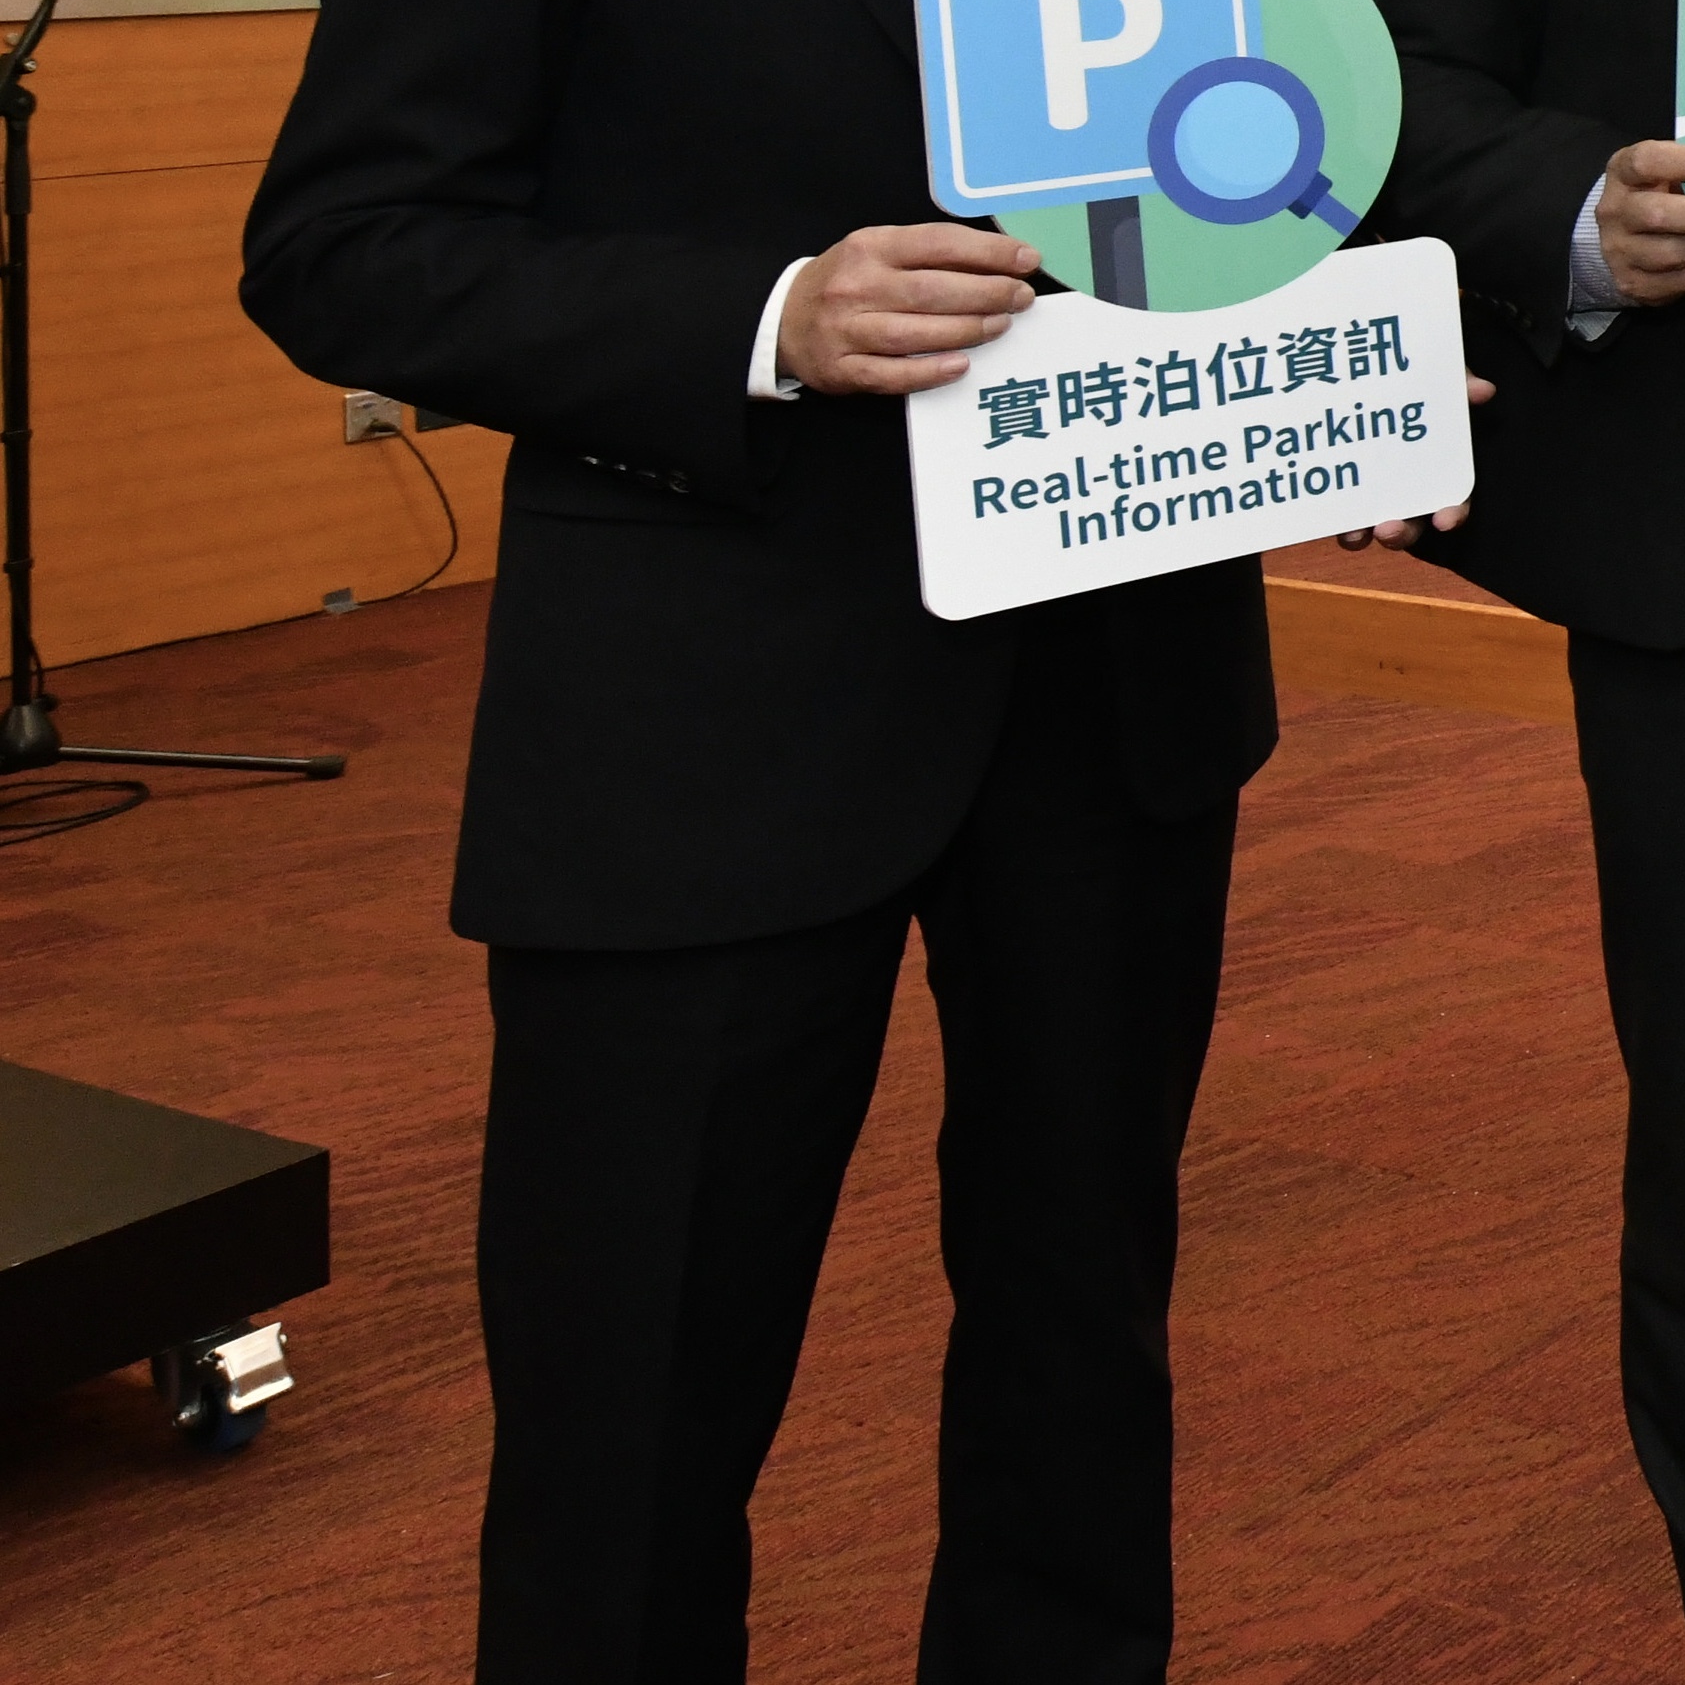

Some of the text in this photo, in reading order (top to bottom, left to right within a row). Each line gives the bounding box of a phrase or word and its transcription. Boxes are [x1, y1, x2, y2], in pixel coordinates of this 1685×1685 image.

[978, 315, 1410, 449] 實時泊位資訊
[972, 397, 1429, 518] Real-time Parking
[1060, 456, 1361, 548] Information
